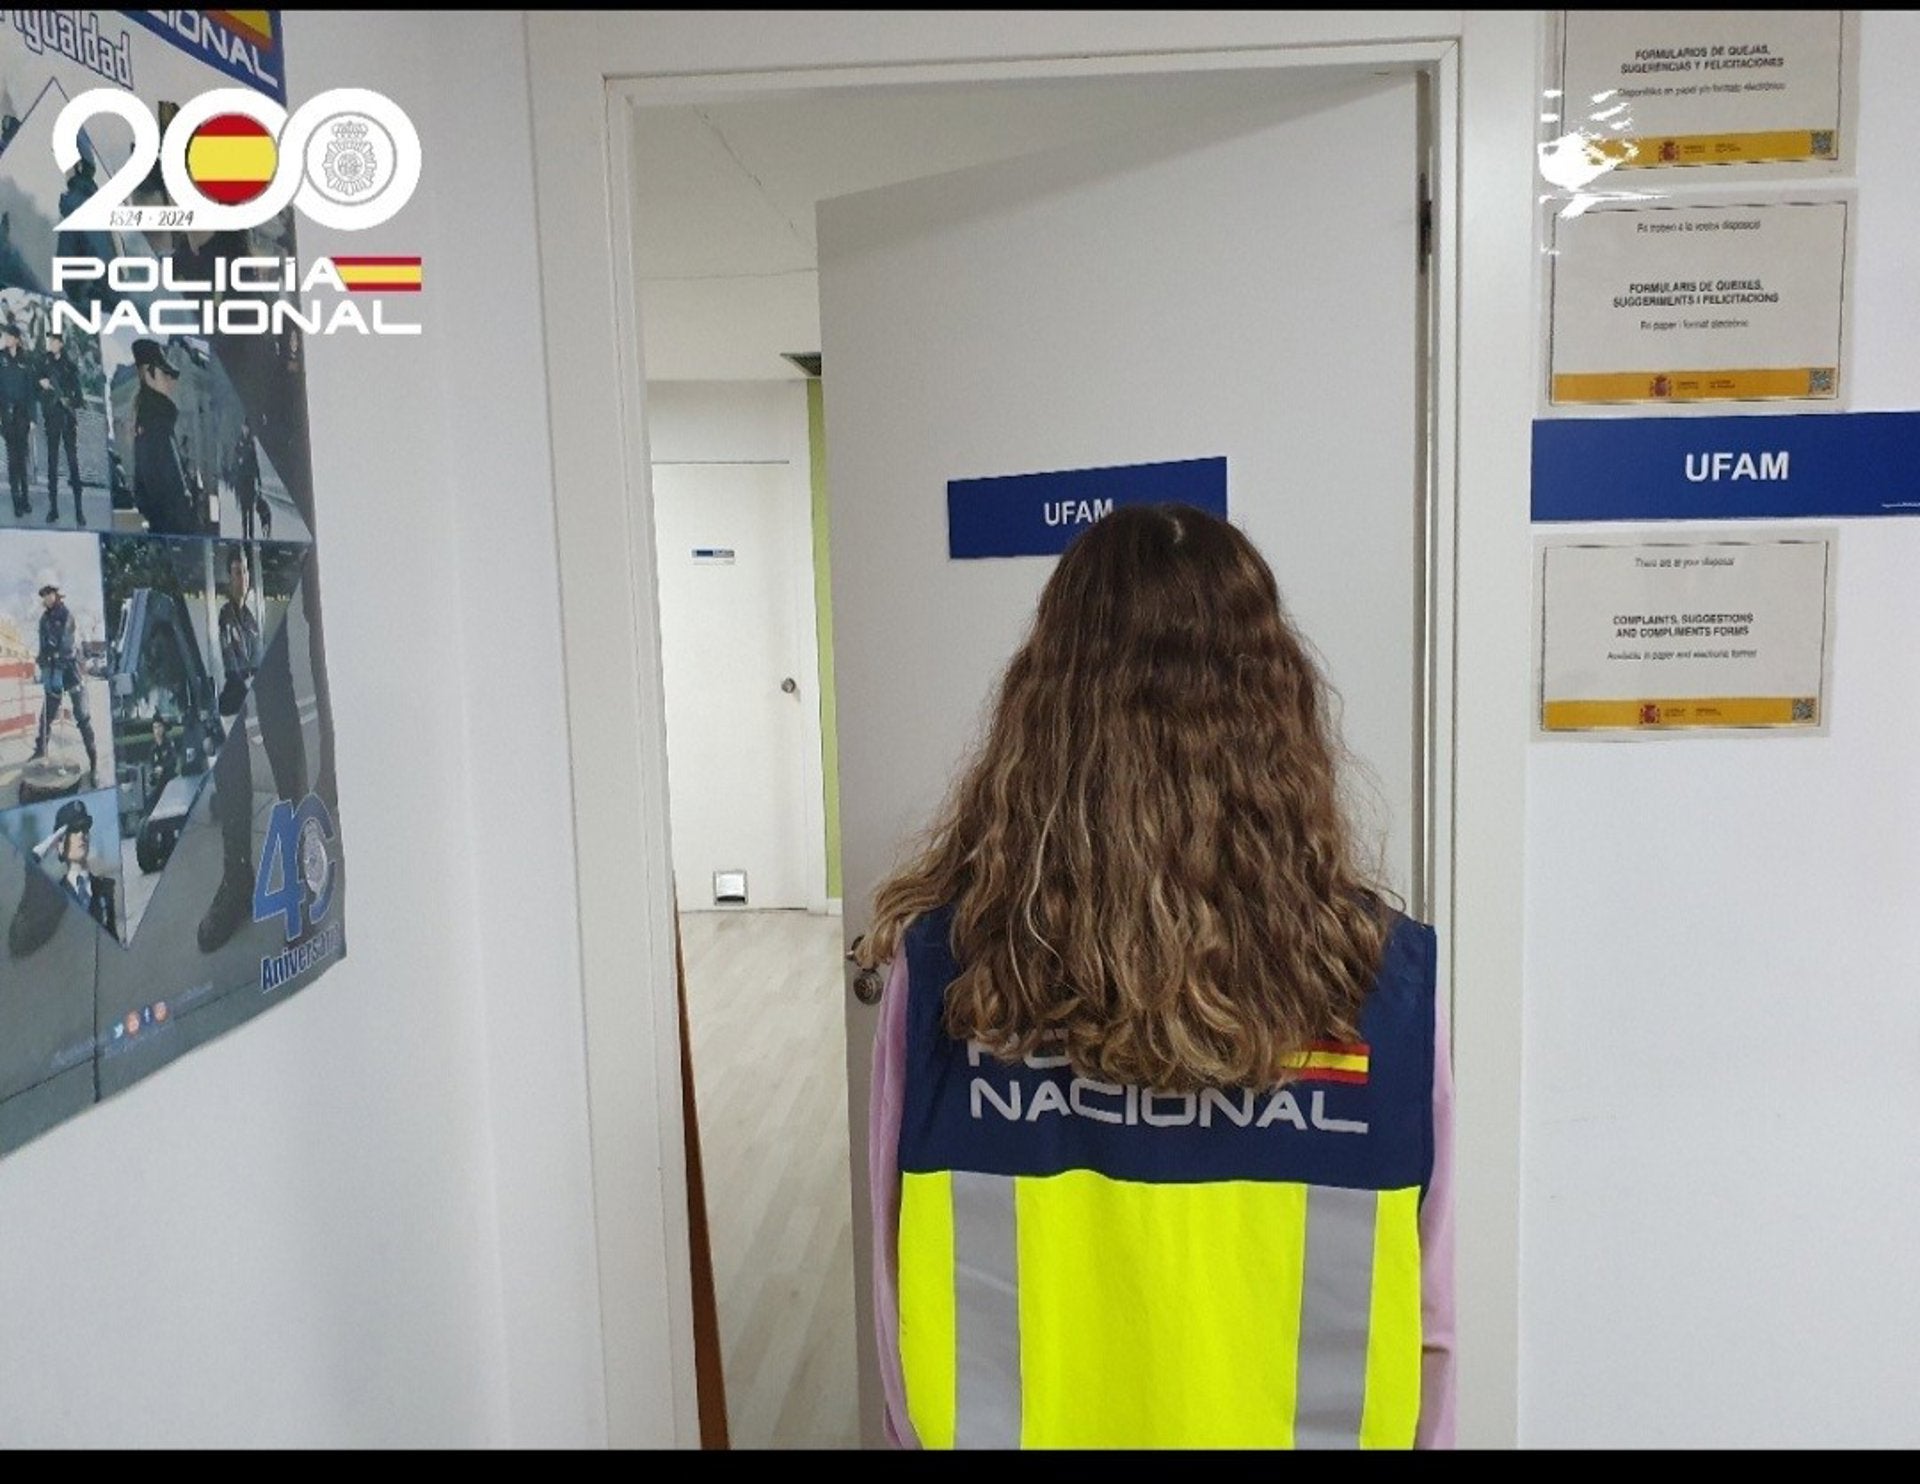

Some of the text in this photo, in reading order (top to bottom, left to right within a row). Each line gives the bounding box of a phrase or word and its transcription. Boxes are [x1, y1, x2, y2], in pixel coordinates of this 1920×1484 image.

[1635, 48, 1707, 60] FORMULARIOS
[1712, 46, 1725, 57] DE
[1621, 57, 1784, 74] SUGERENCIAS Y FELICITACIONES
[1629, 281, 1696, 294] FORMULARIS
[1700, 282, 1713, 292] DE
[1613, 294, 1694, 308] SUGGERIMENTS
[1702, 292, 1779, 305] FELICITACIONS
[1684, 451, 1790, 482] UFAM
[1044, 498, 1114, 526] UFAM
[1681, 612, 1754, 624] SUGGESTIONS
[1616, 625, 1749, 639] AND COMPLIMENTS FORMS
[969, 1077, 1369, 1134] NACIONAL
